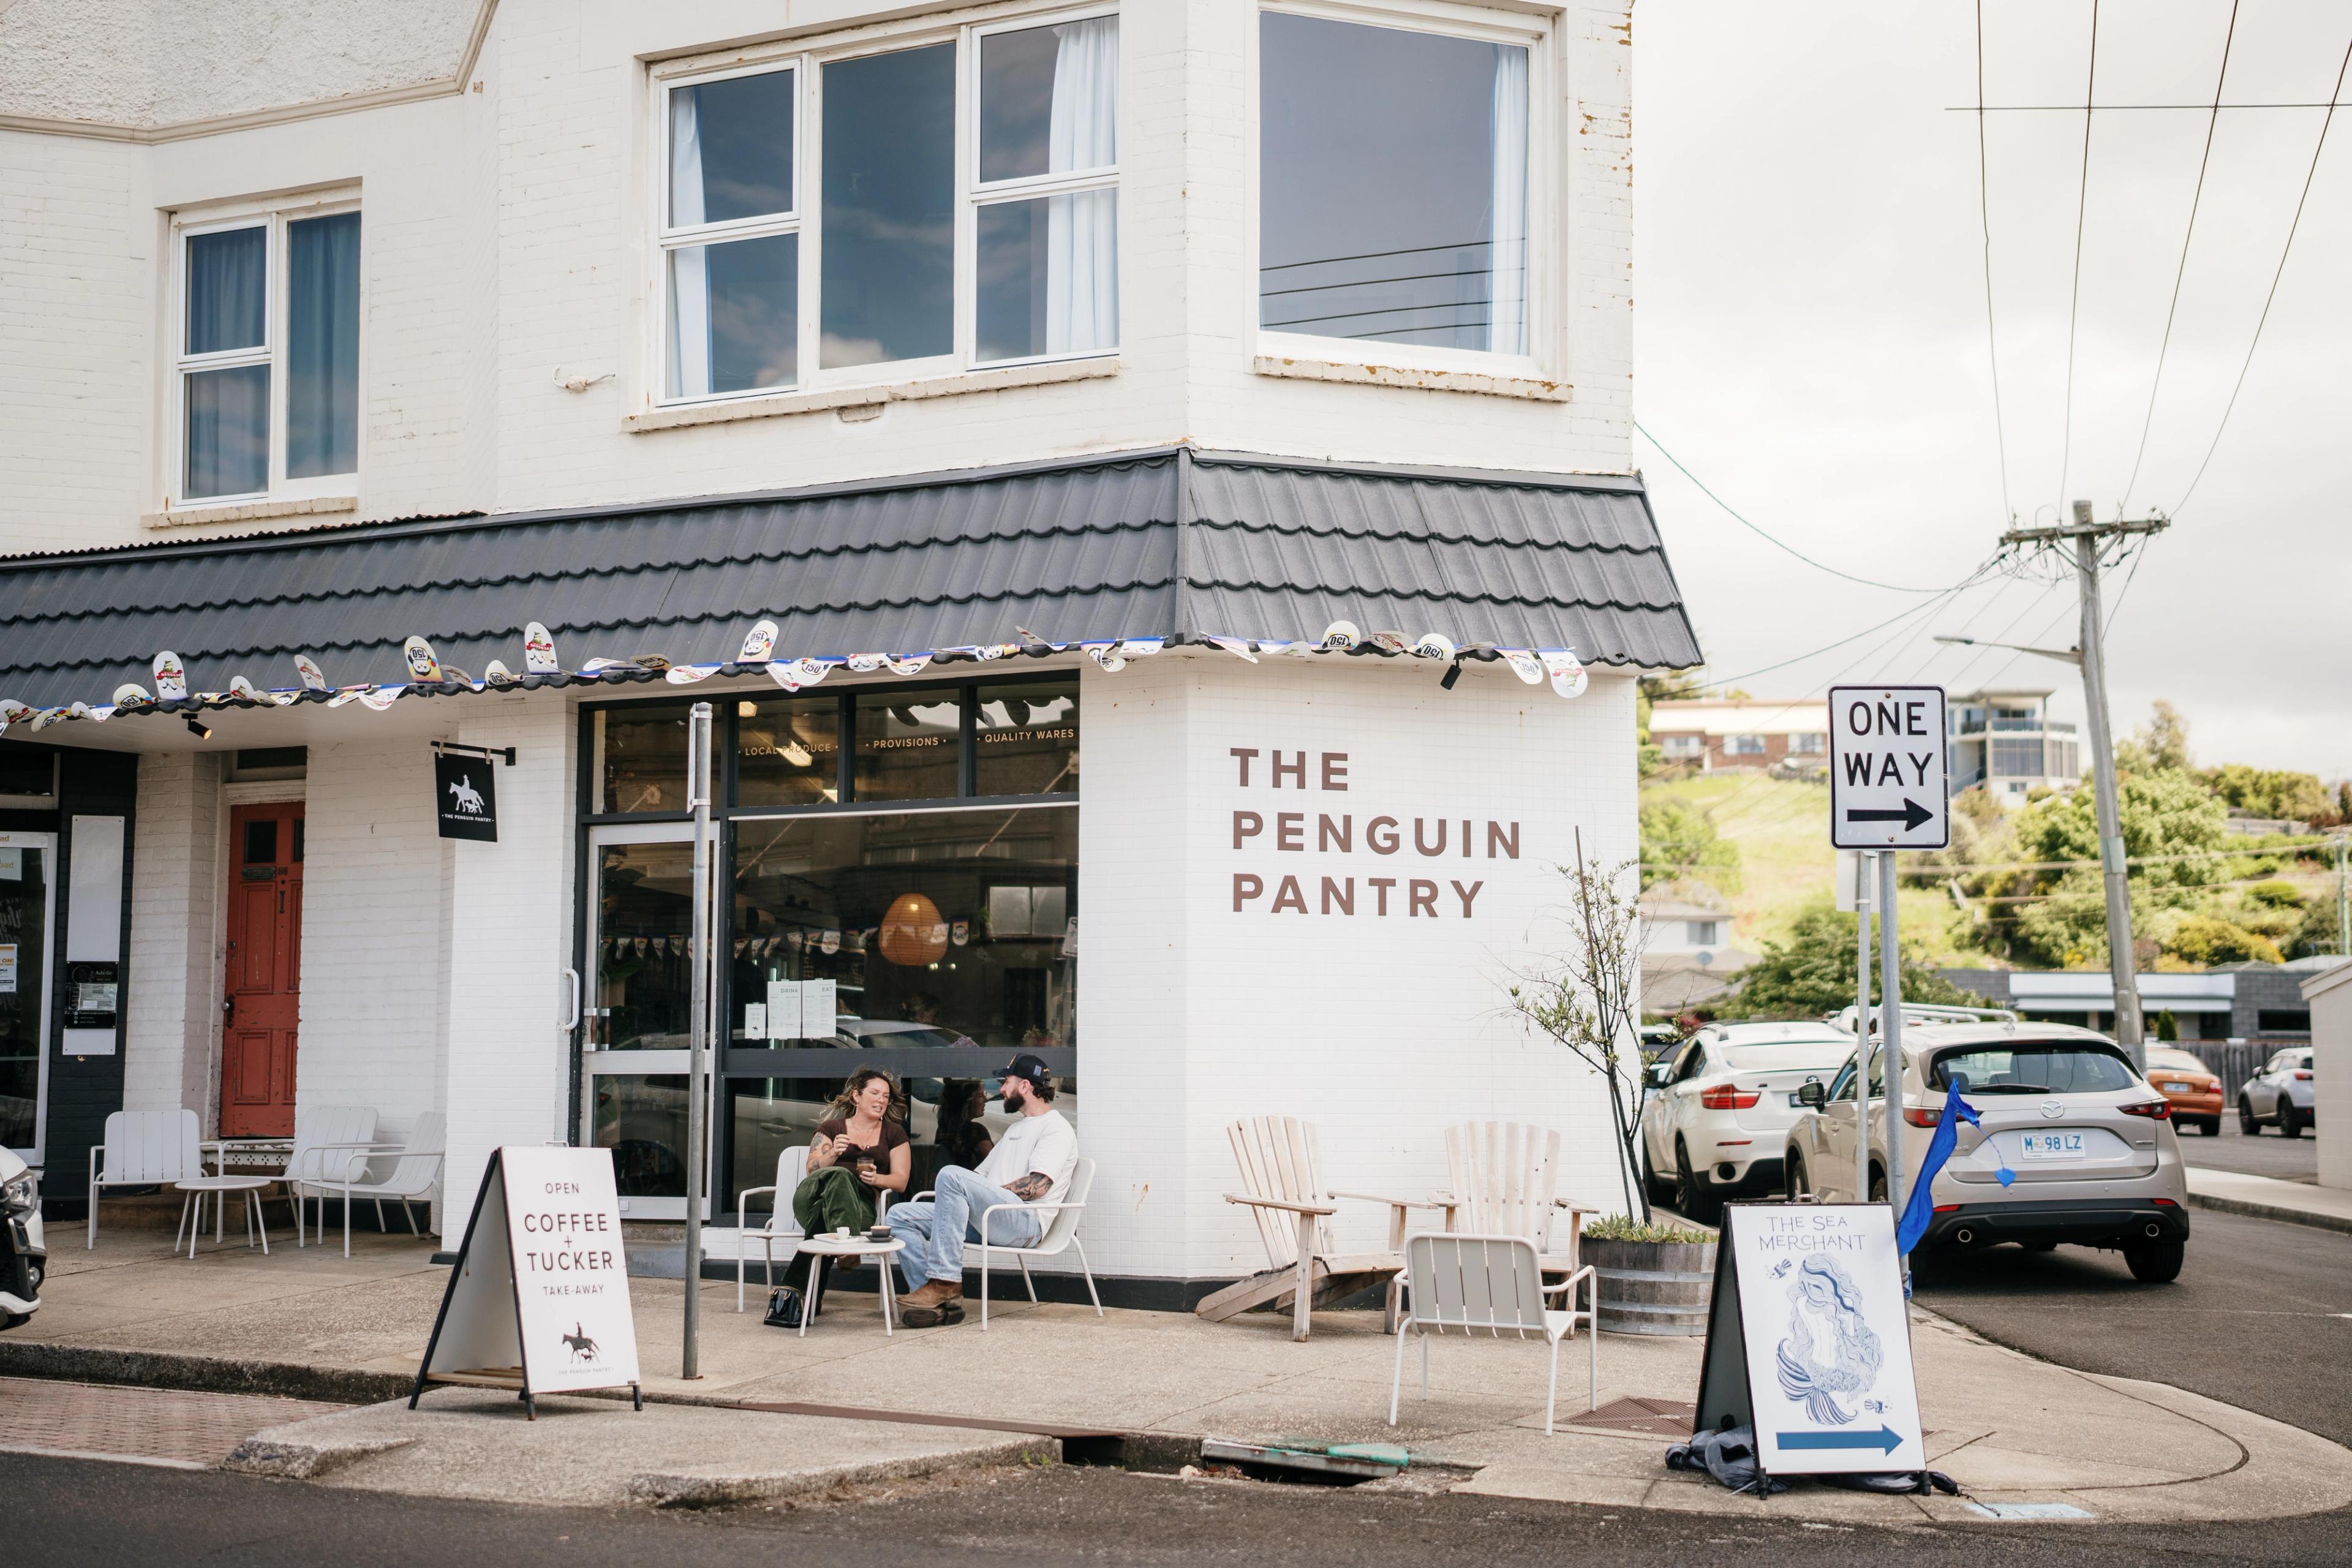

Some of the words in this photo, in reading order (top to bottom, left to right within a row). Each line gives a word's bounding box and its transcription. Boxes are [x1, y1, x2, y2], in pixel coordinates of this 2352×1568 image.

[750, 632, 765, 641] 150
[1330, 636, 1346, 646] 150
[412, 649, 426, 658] 150
[1423, 646, 1440, 658] 150
[805, 664, 821, 673] 150
[1521, 663, 1535, 673] 150
[491, 674, 505, 683] 150
[123, 697, 138, 707] 150
[1849, 701, 1927, 736] ONE
[985, 731, 1033, 742] QUALITY
[1036, 729, 1074, 739] WARES
[873, 737, 938, 748] PROVISIONS
[745, 747, 777, 756] LOCAL
[782, 744, 831, 753] PRODUCE
[1230, 747, 1348, 791] THE
[1844, 752, 1933, 786] WAY
[1233, 810, 1520, 859] PENGUIN
[1233, 873, 1484, 918] PANTRY
[2024, 1137, 2033, 1150] M
[2045, 1136, 2060, 1150] 98
[2065, 1136, 2081, 1149] LZ
[545, 1183, 579, 1194] OPEN
[524, 1213, 608, 1232] COFFEE
[1766, 1216, 1805, 1232] THE
[1812, 1216, 1848, 1231] SEA
[1759, 1235, 1866, 1251] MERCHANT
[527, 1251, 613, 1271] TUCKER
[543, 1284, 604, 1295] TAKE-AWAY
